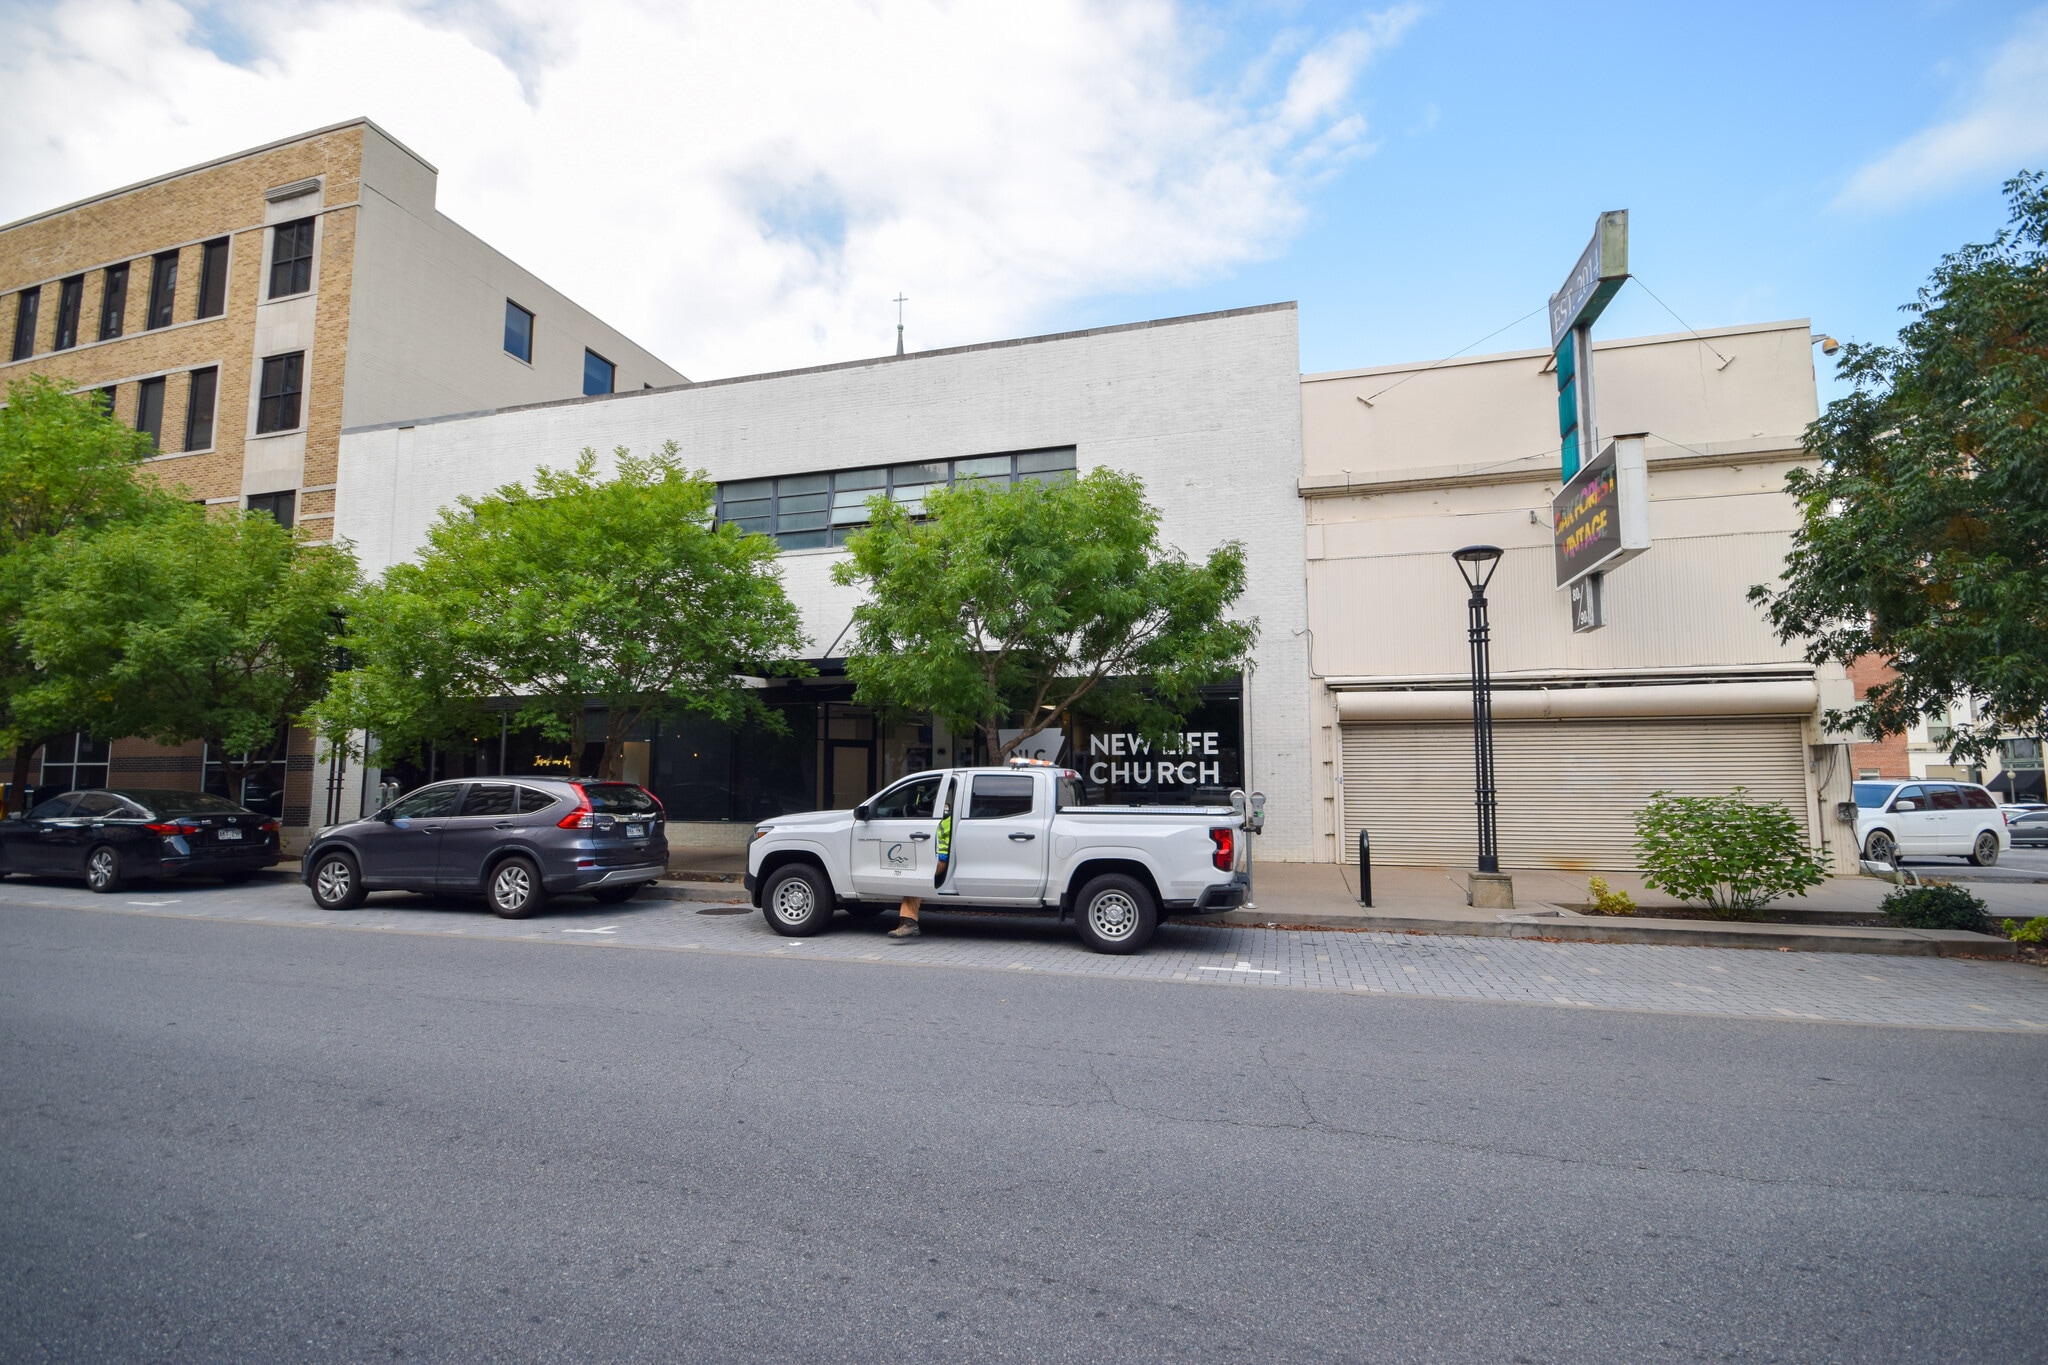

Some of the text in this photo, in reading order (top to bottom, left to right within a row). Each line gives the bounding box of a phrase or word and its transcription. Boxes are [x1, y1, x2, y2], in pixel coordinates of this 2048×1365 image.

[1553, 247, 1599, 334] EST. 2014
[1573, 464, 1615, 520] FOREST
[1562, 509, 1608, 560] VINTAGE
[1090, 733, 1151, 756] NEW
[1089, 761, 1220, 785] CHURCH
